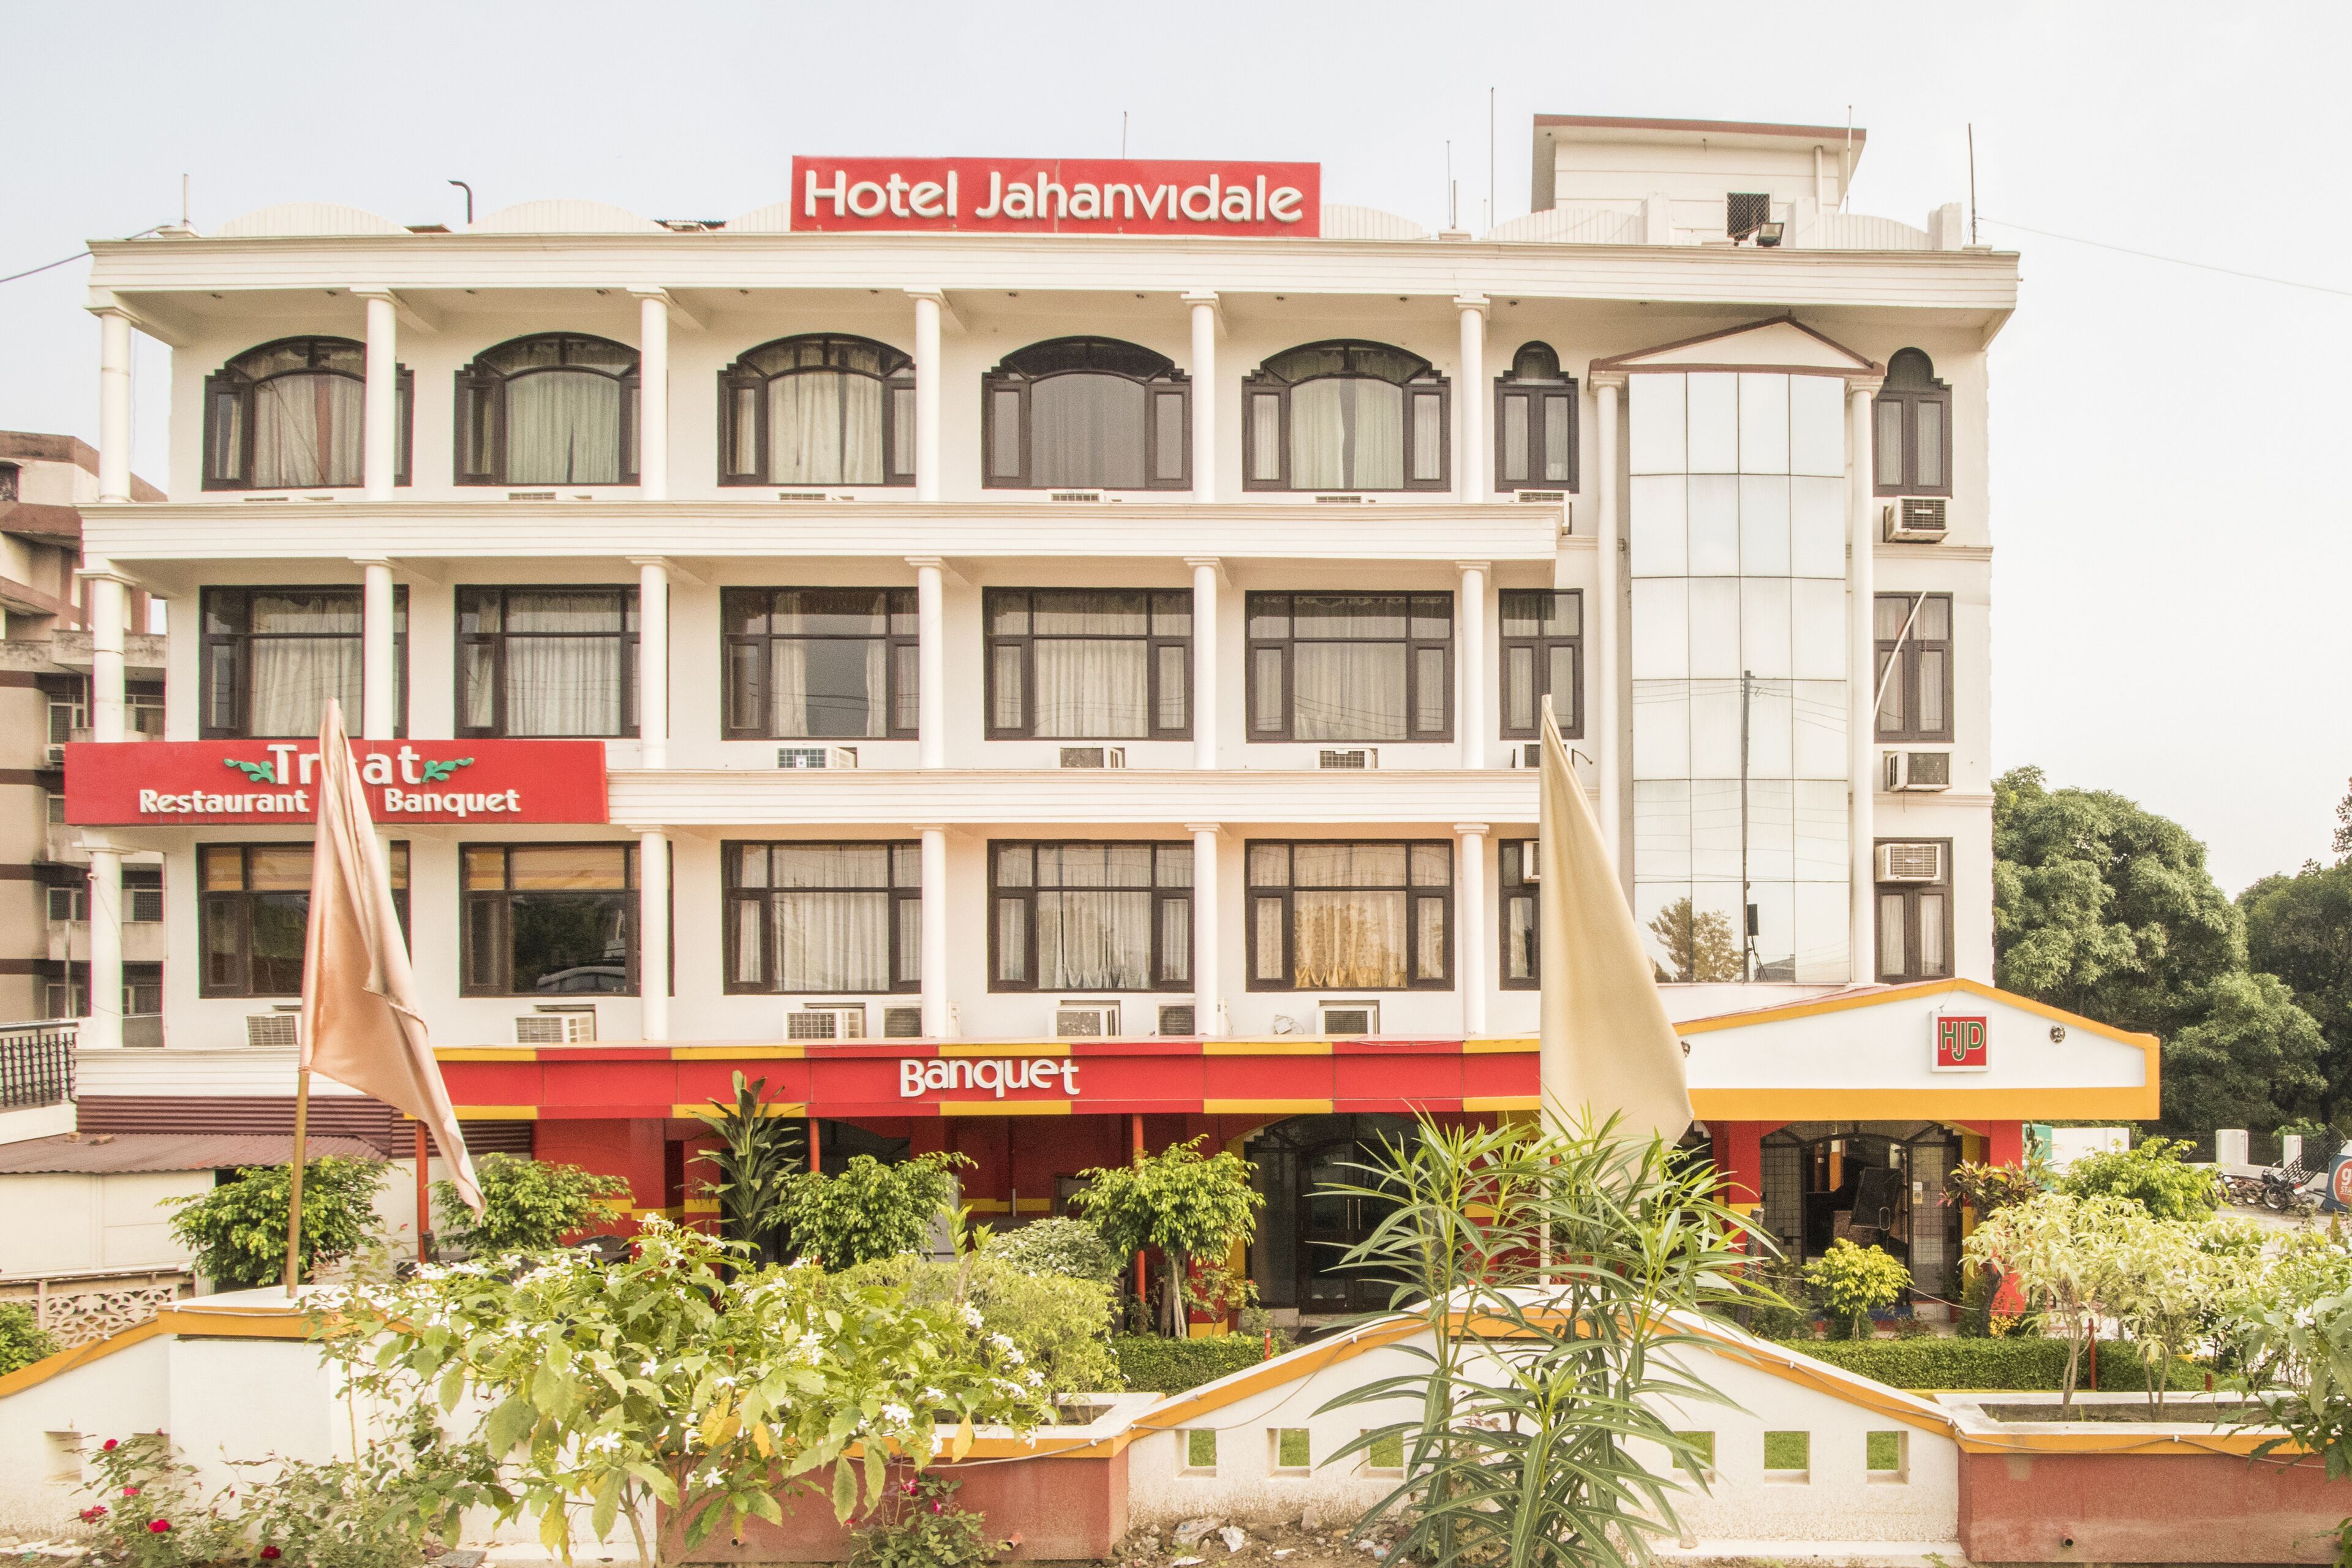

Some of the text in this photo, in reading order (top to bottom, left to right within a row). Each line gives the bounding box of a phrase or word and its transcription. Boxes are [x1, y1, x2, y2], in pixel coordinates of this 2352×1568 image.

[805, 170, 1304, 222] Hotel Jahanvidale
[267, 744, 423, 785] Trat
[139, 788, 522, 818] Restaurant Banquet
[1940, 1021, 1985, 1061] HJD
[900, 1058, 1081, 1098] Banquet
